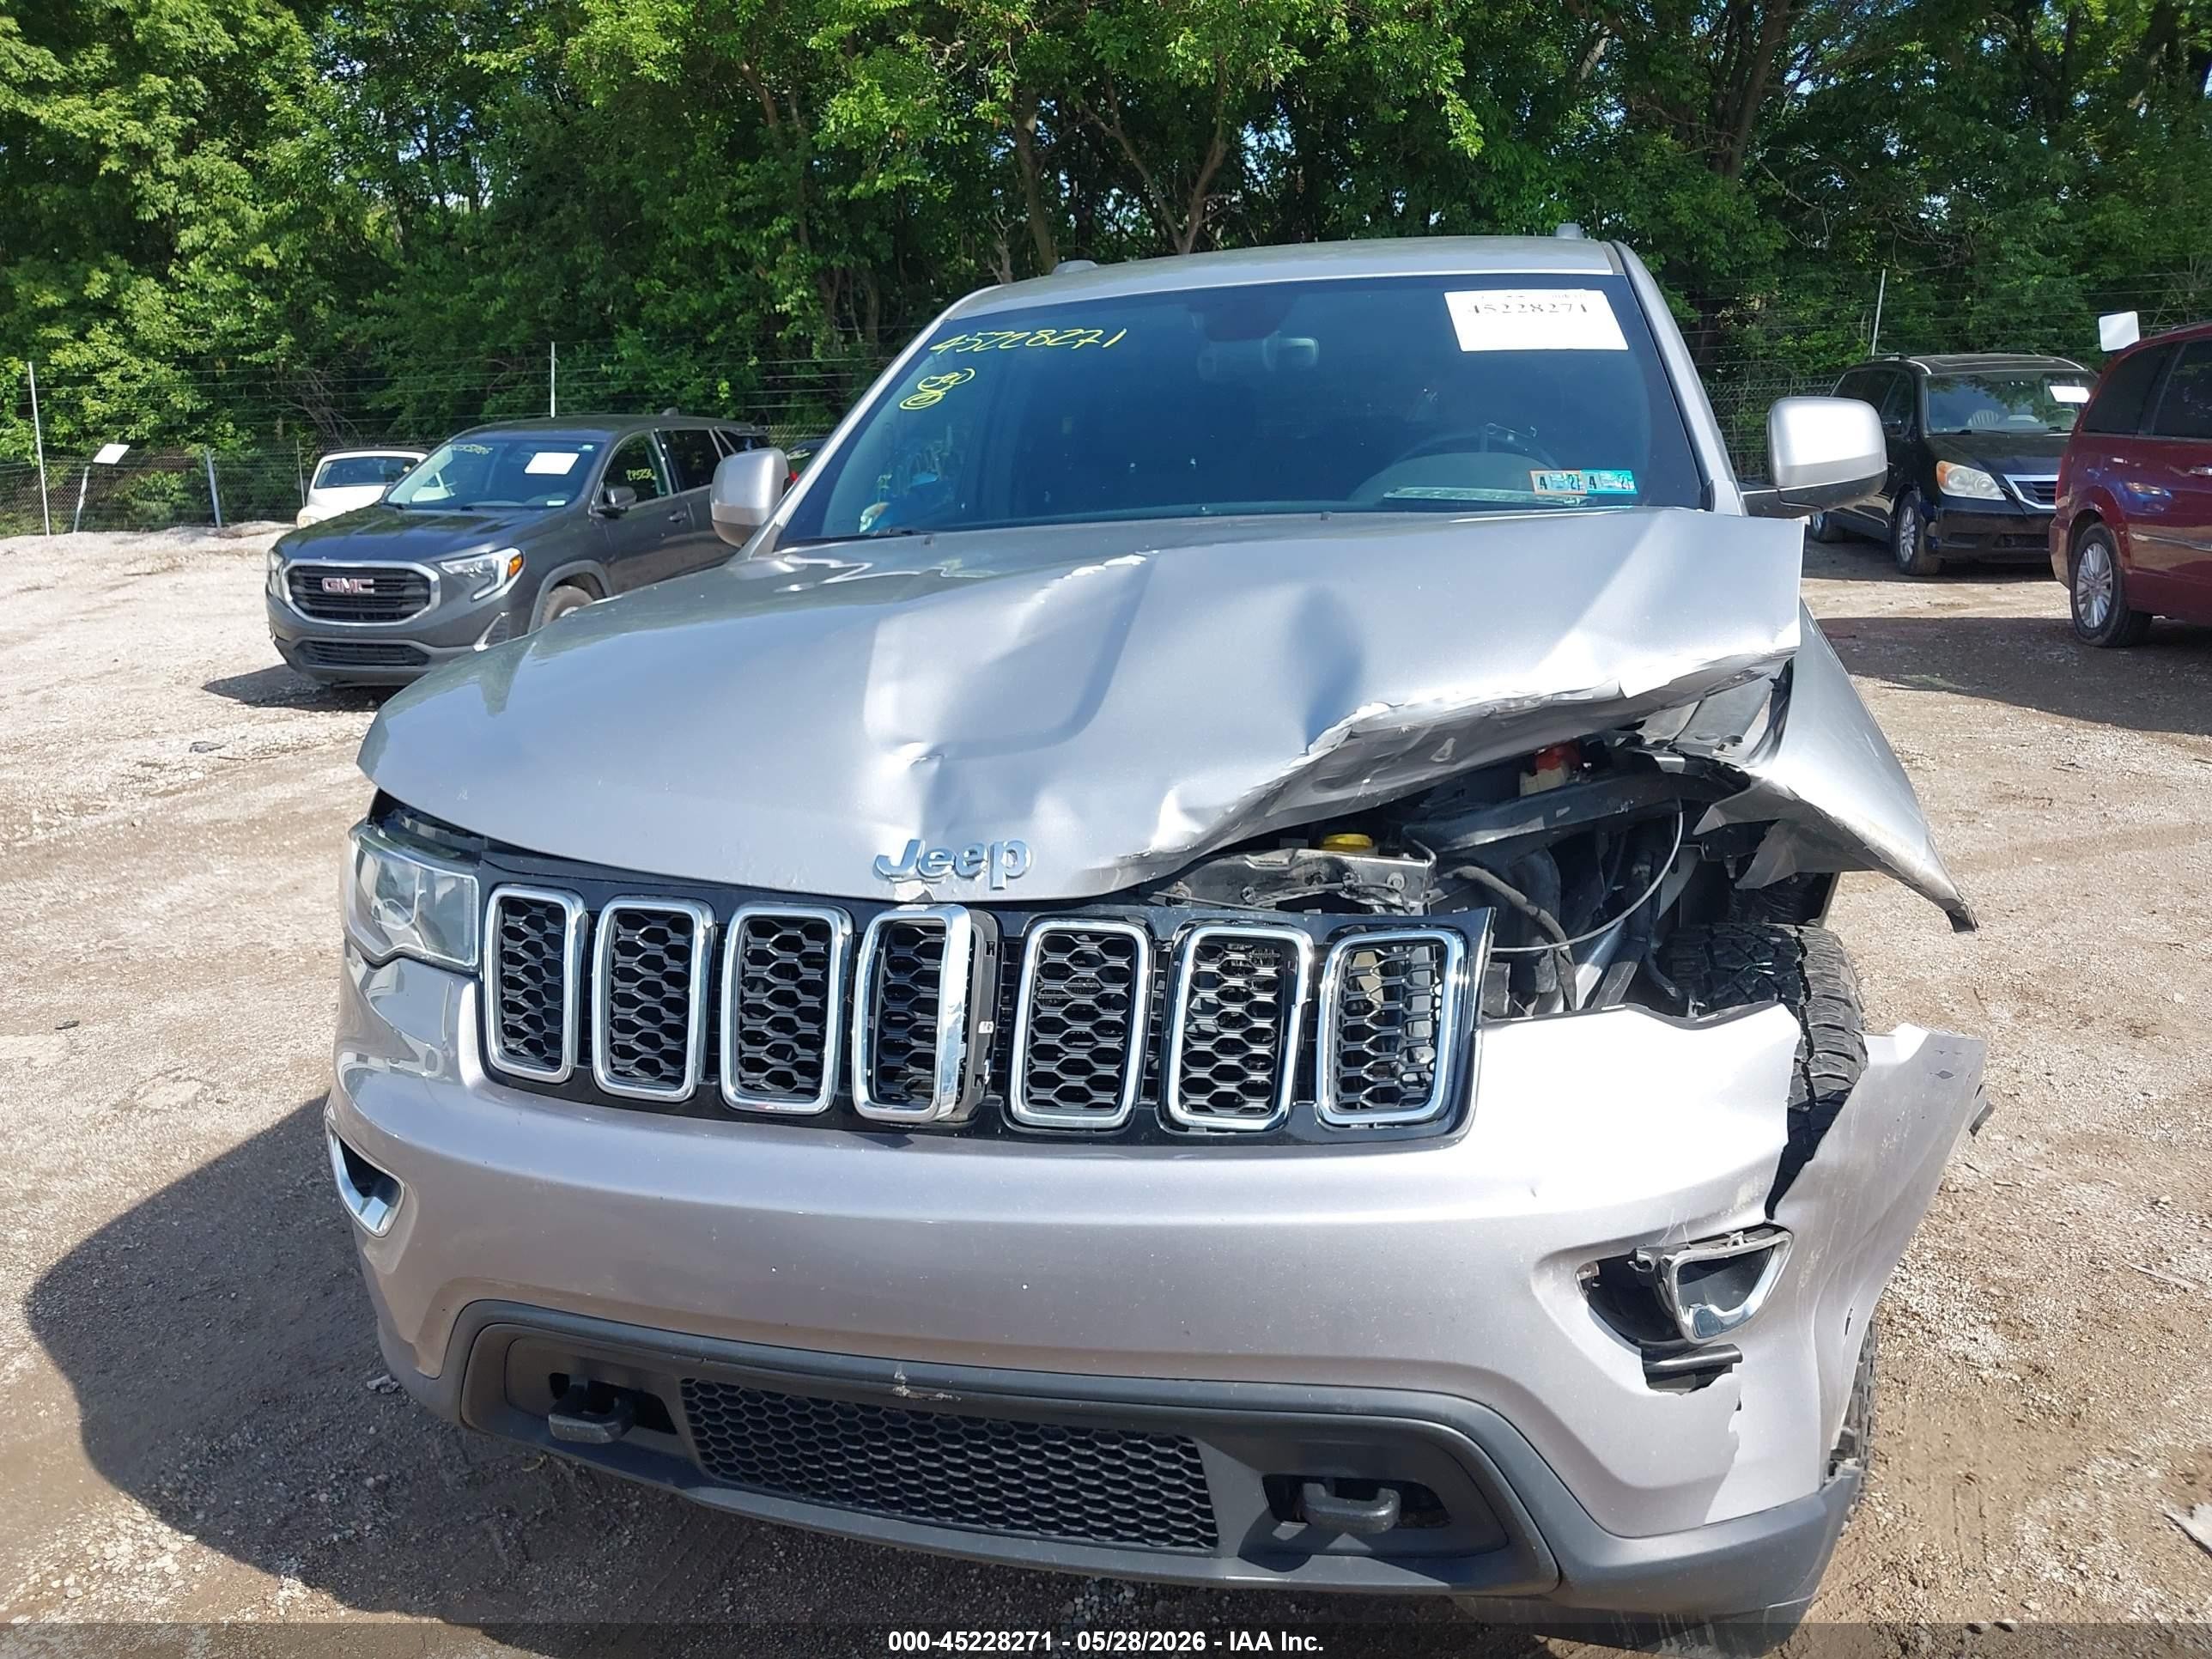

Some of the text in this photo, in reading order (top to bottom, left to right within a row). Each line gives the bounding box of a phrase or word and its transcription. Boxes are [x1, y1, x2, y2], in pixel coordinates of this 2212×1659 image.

[929, 327, 1127, 355] 45228271
[322, 577, 375, 594] GMC
[872, 838, 1031, 890] Jeep
